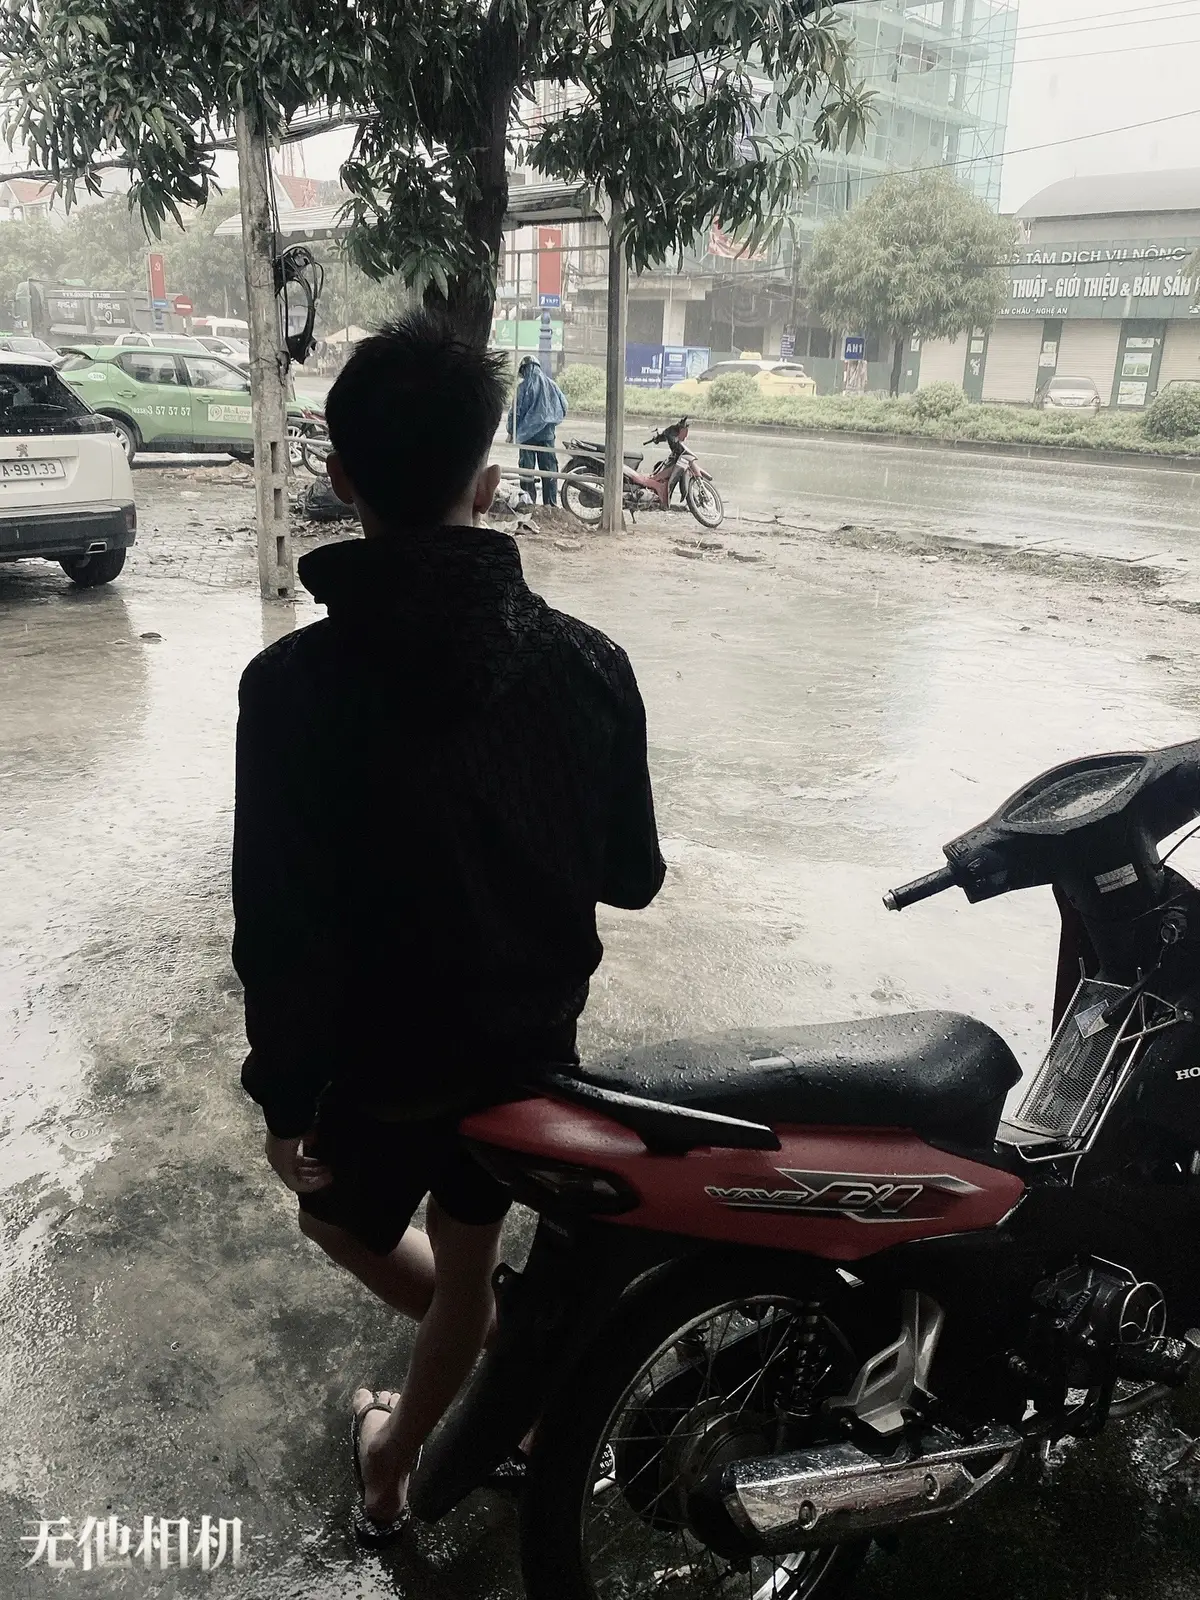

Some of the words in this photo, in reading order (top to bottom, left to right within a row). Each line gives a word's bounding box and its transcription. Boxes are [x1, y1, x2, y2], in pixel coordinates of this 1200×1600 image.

[1026, 249, 1057, 264] TÂM
[1061, 250, 1102, 267] DỊCH
[1106, 248, 1128, 266] VỤ
[1132, 244, 1187, 262] NÔNG
[1012, 274, 1048, 303] THUẬT
[1055, 273, 1082, 298] GIỚI
[1083, 273, 1120, 301] THIỆU
[1120, 283, 1132, 296] &
[1133, 271, 1161, 297] BÁN
[846, 344, 863, 353] AH1
[155, 405, 166, 416] 57
[168, 406, 179, 416] 57
[180, 406, 191, 417] 57
[704, 1186, 808, 1203] WAVE
